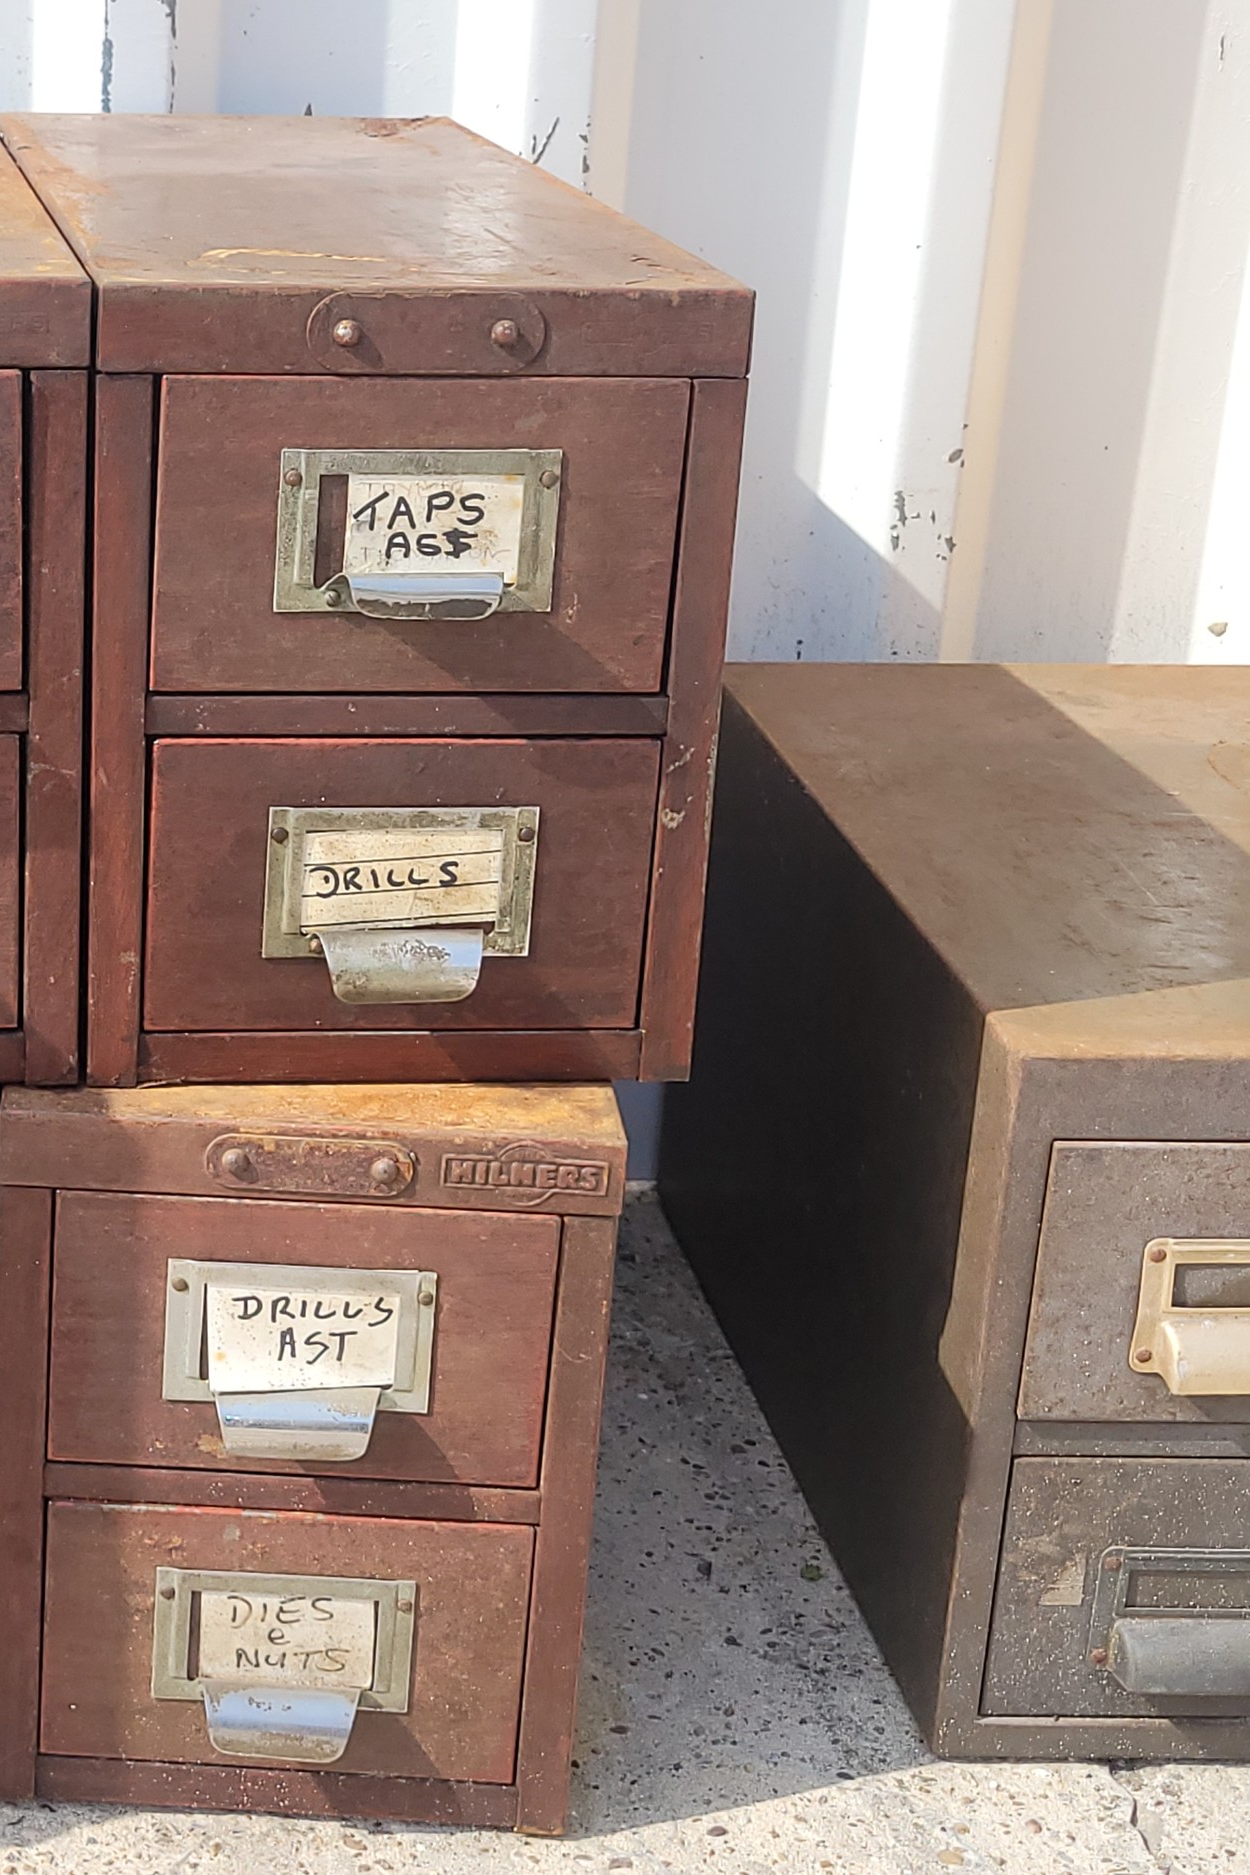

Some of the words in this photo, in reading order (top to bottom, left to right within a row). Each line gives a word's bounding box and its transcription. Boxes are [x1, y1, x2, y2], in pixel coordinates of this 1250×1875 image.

[352, 490, 486, 532] TAPS
[308, 860, 459, 898] DRILLS
[450, 1159, 600, 1191] MILNERS
[231, 1295, 394, 1327] DRILLS
[277, 1327, 358, 1365] AST
[226, 1595, 335, 1629] DIES
[235, 1648, 351, 1673] NUTS
